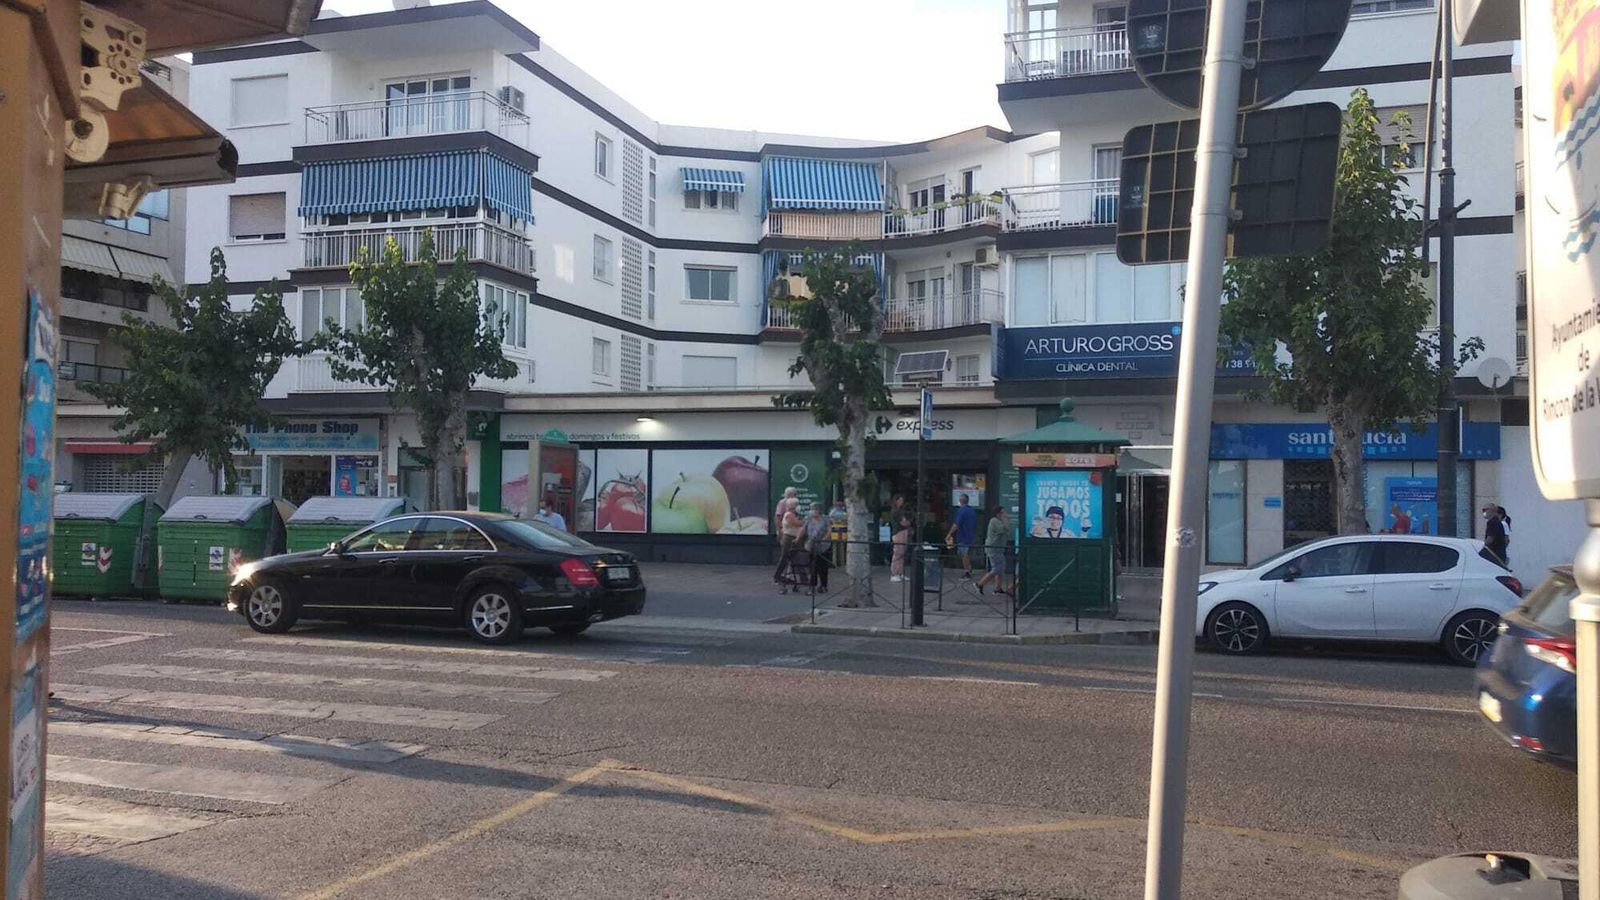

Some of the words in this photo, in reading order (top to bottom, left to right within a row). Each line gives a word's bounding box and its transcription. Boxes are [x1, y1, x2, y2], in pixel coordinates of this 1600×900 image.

[1578, 343, 1589, 372] de
[1097, 361, 1138, 372] DENTAL
[1572, 384, 1584, 413] de
[1586, 379, 1595, 409] la
[322, 420, 358, 436] Shop
[896, 420, 954, 433] expess
[569, 432, 606, 442] domingos
[611, 432, 640, 440] festivos
[1037, 486, 1090, 499] JUGAMOS
